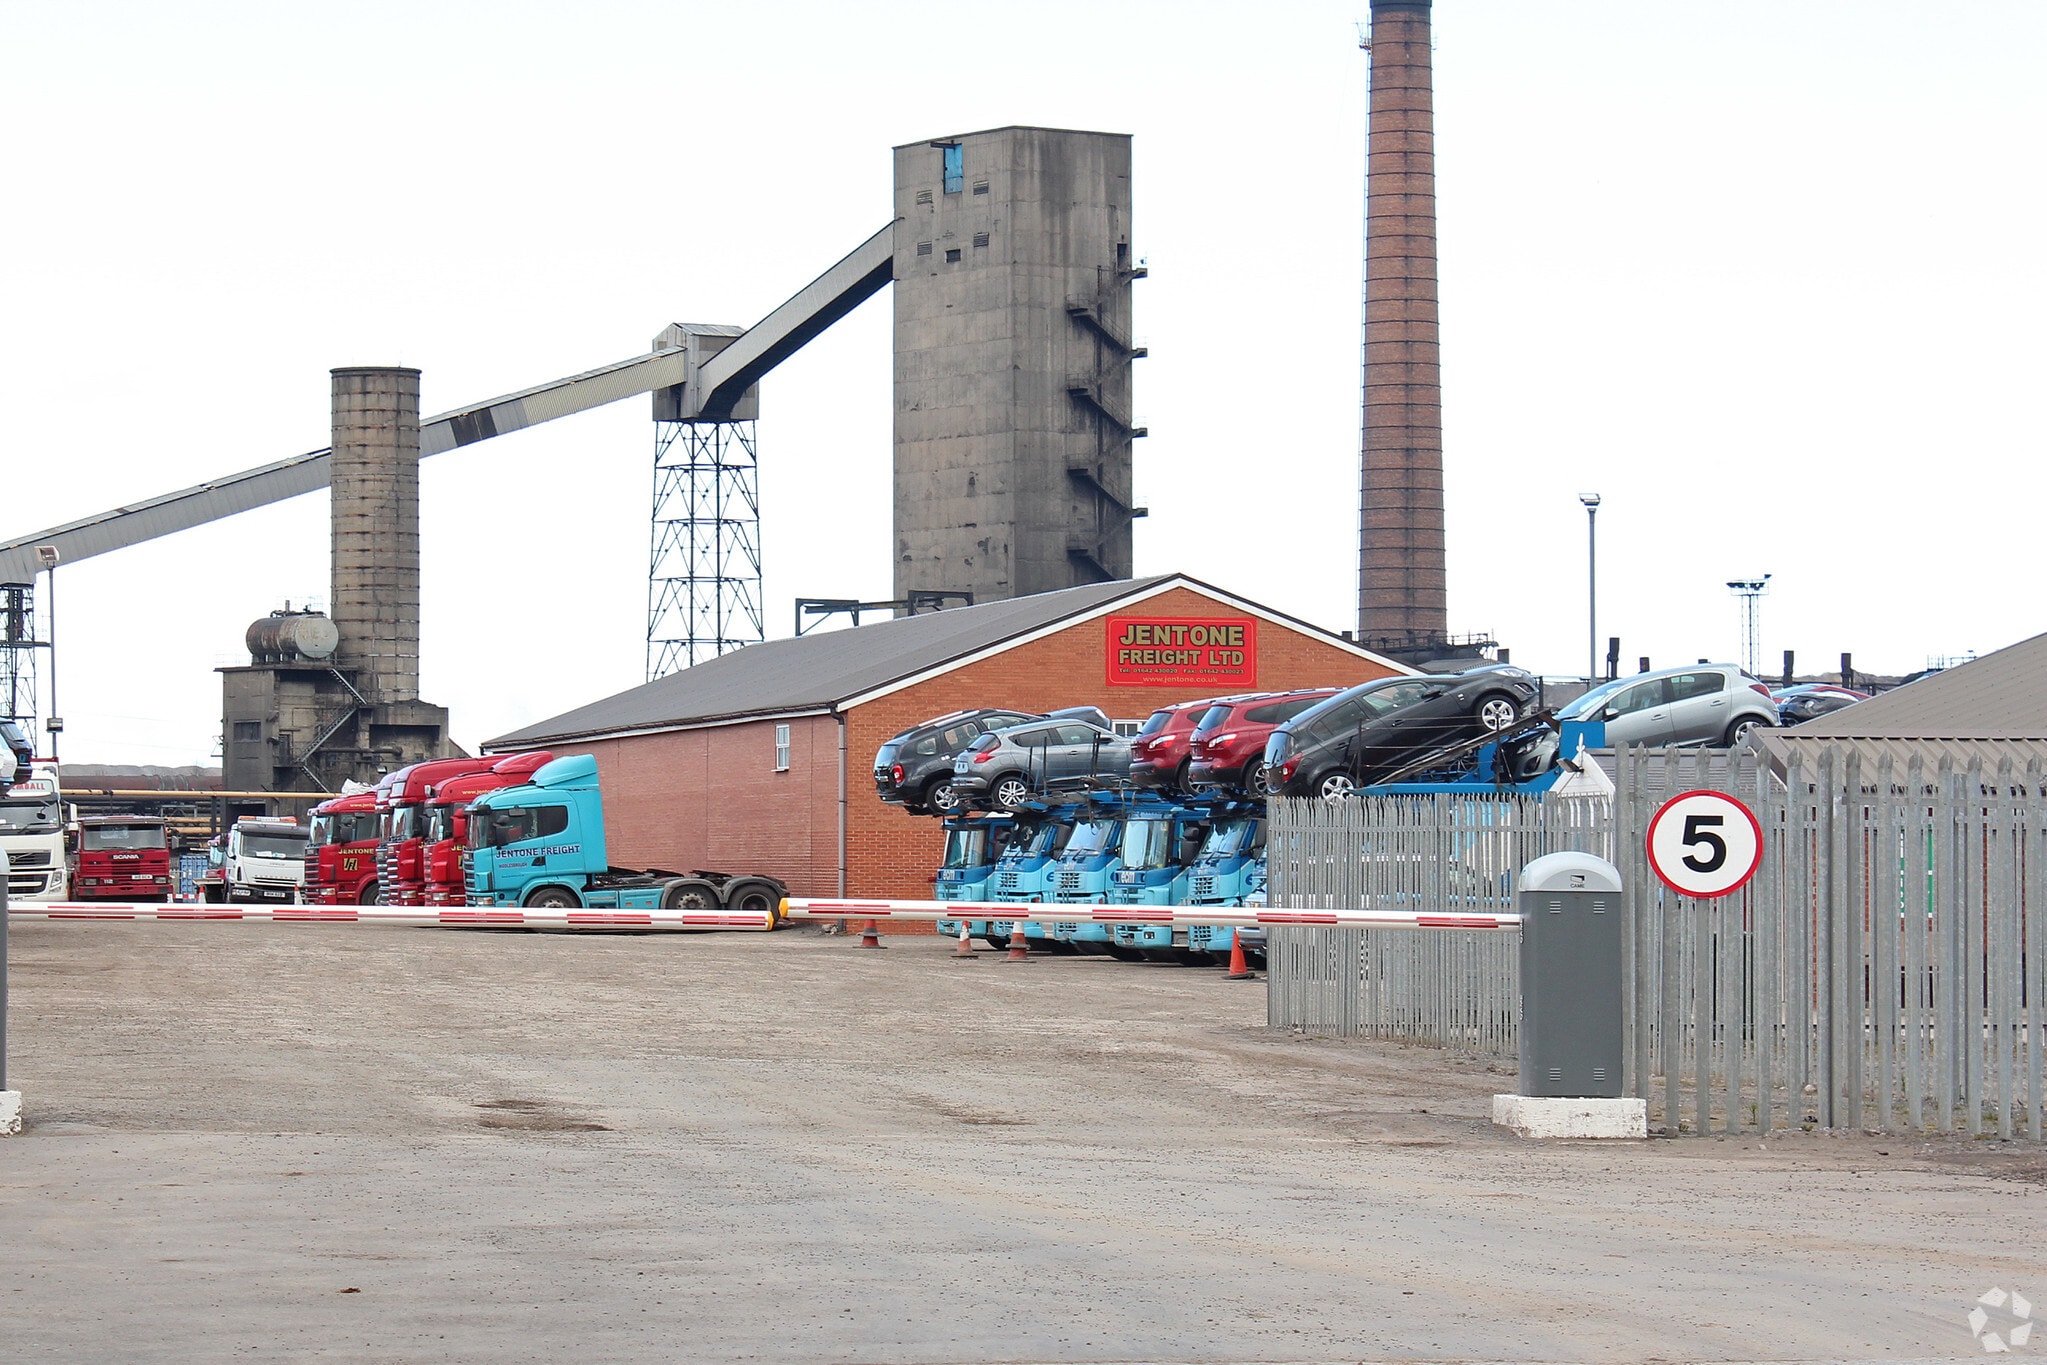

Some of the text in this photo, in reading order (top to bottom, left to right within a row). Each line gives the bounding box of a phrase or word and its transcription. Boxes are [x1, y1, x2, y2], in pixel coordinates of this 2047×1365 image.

[1119, 624, 1244, 646] JENTONE
[1118, 649, 1244, 665] FREIGHT LTD
[1142, 675, 1218, 684] www.jentone.co.uk
[338, 847, 375, 855] JENTONE
[1682, 815, 1727, 873] 5
[496, 845, 581, 859] JENTONE FREIGHT
